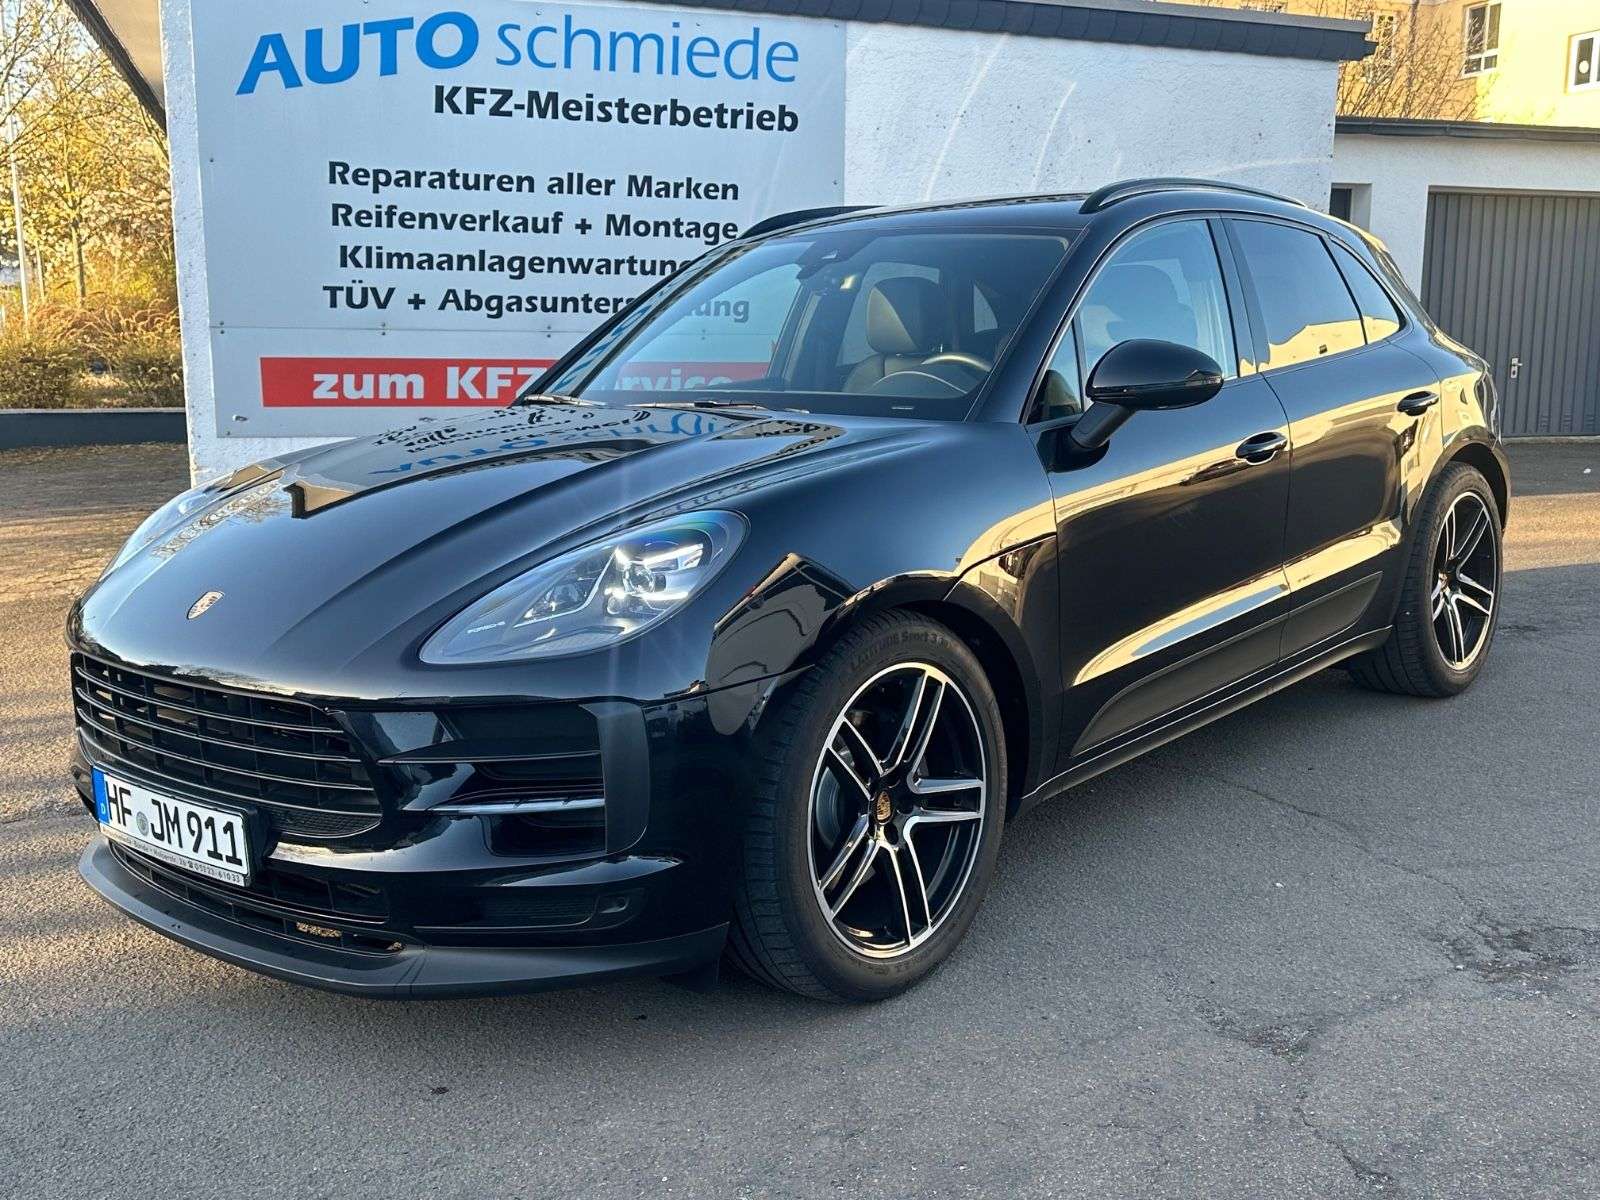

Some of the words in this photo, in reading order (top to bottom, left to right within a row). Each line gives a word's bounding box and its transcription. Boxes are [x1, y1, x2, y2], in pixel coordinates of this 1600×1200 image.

[236, 11, 480, 95] AUTO
[497, 14, 799, 83] schmiede
[434, 84, 799, 132] KFZ-Meisterbetrieb
[328, 161, 535, 194] Reparaturen
[547, 172, 615, 196] aller
[627, 175, 739, 200] Marken
[331, 203, 563, 234] Reifenverkauf
[574, 218, 592, 235] +
[605, 214, 738, 245] Montage
[323, 280, 396, 310] TÜV
[407, 293, 426, 310] +
[313, 373, 424, 399] zum
[105, 781, 132, 827] HF
[150, 798, 183, 849] JM
[186, 810, 243, 867] 911
